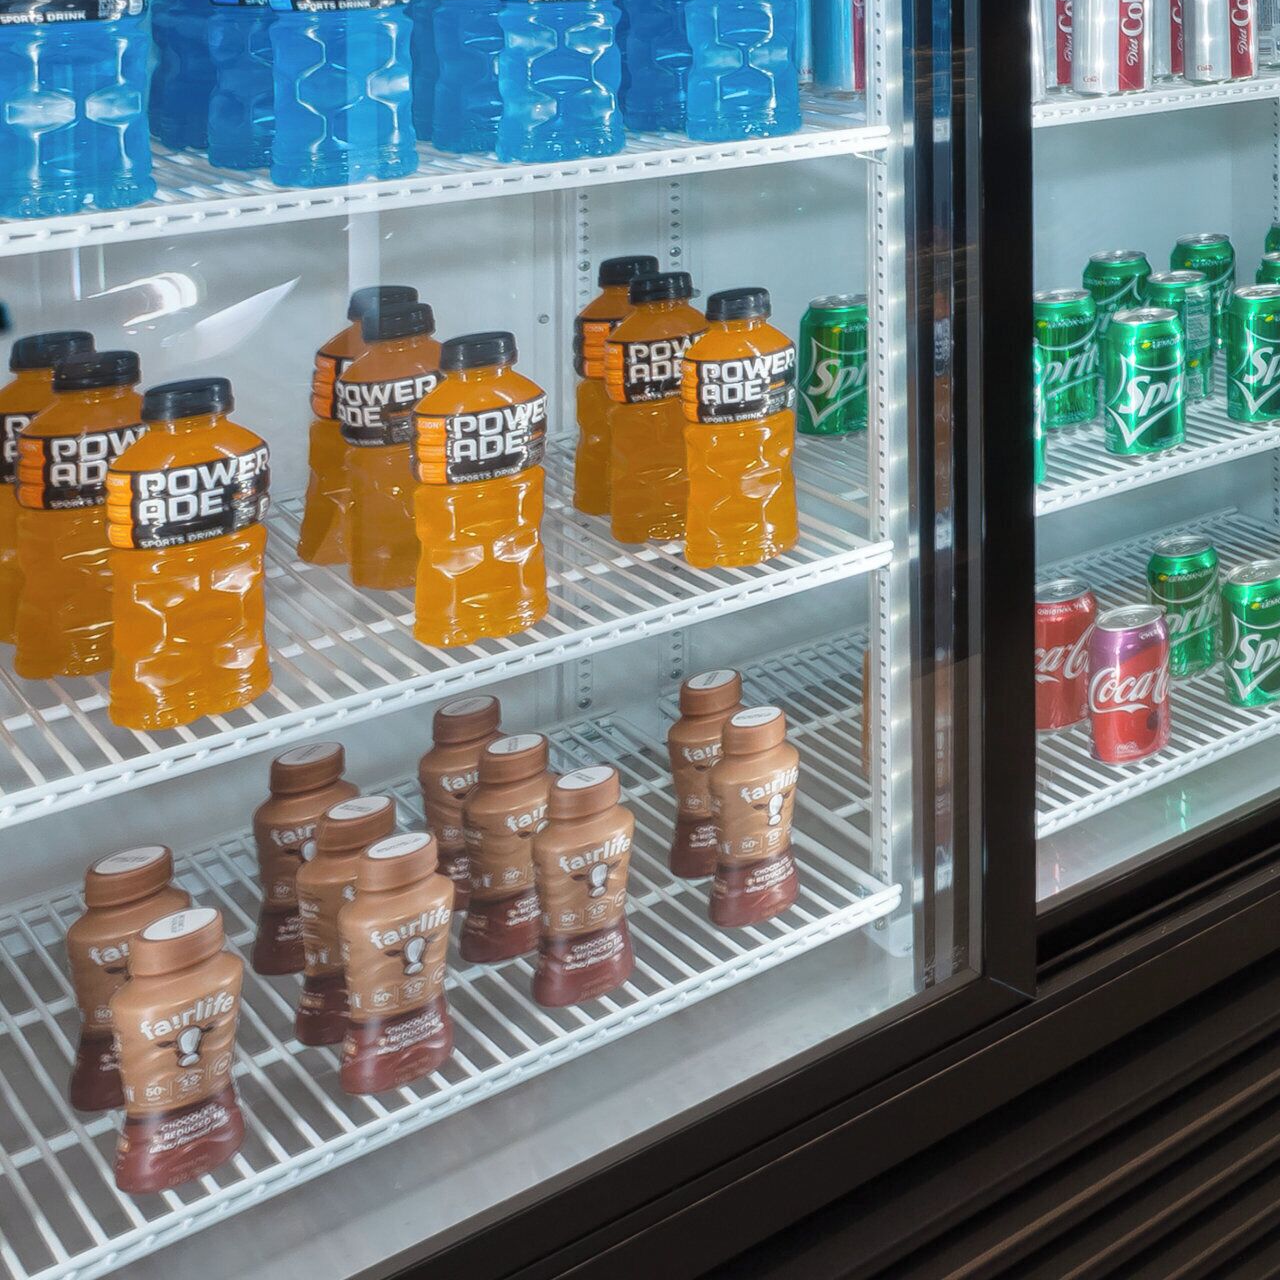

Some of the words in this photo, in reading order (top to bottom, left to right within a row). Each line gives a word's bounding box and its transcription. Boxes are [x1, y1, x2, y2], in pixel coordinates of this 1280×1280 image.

[47, 10, 87, 23] DRINK
[297, 1, 337, 11] SPORTS
[1126, 38, 1140, 67] Diet
[1237, 27, 1250, 55] Diet
[702, 348, 796, 386] POWER
[702, 380, 763, 406] ADE
[703, 414, 735, 425] SPORTS
[737, 412, 764, 422] DRINK
[453, 430, 525, 463] ADE
[138, 448, 270, 500] POWER
[138, 488, 225, 526] ADE
[141, 535, 185, 549] SPORTS
[188, 527, 224, 542] DRINK
